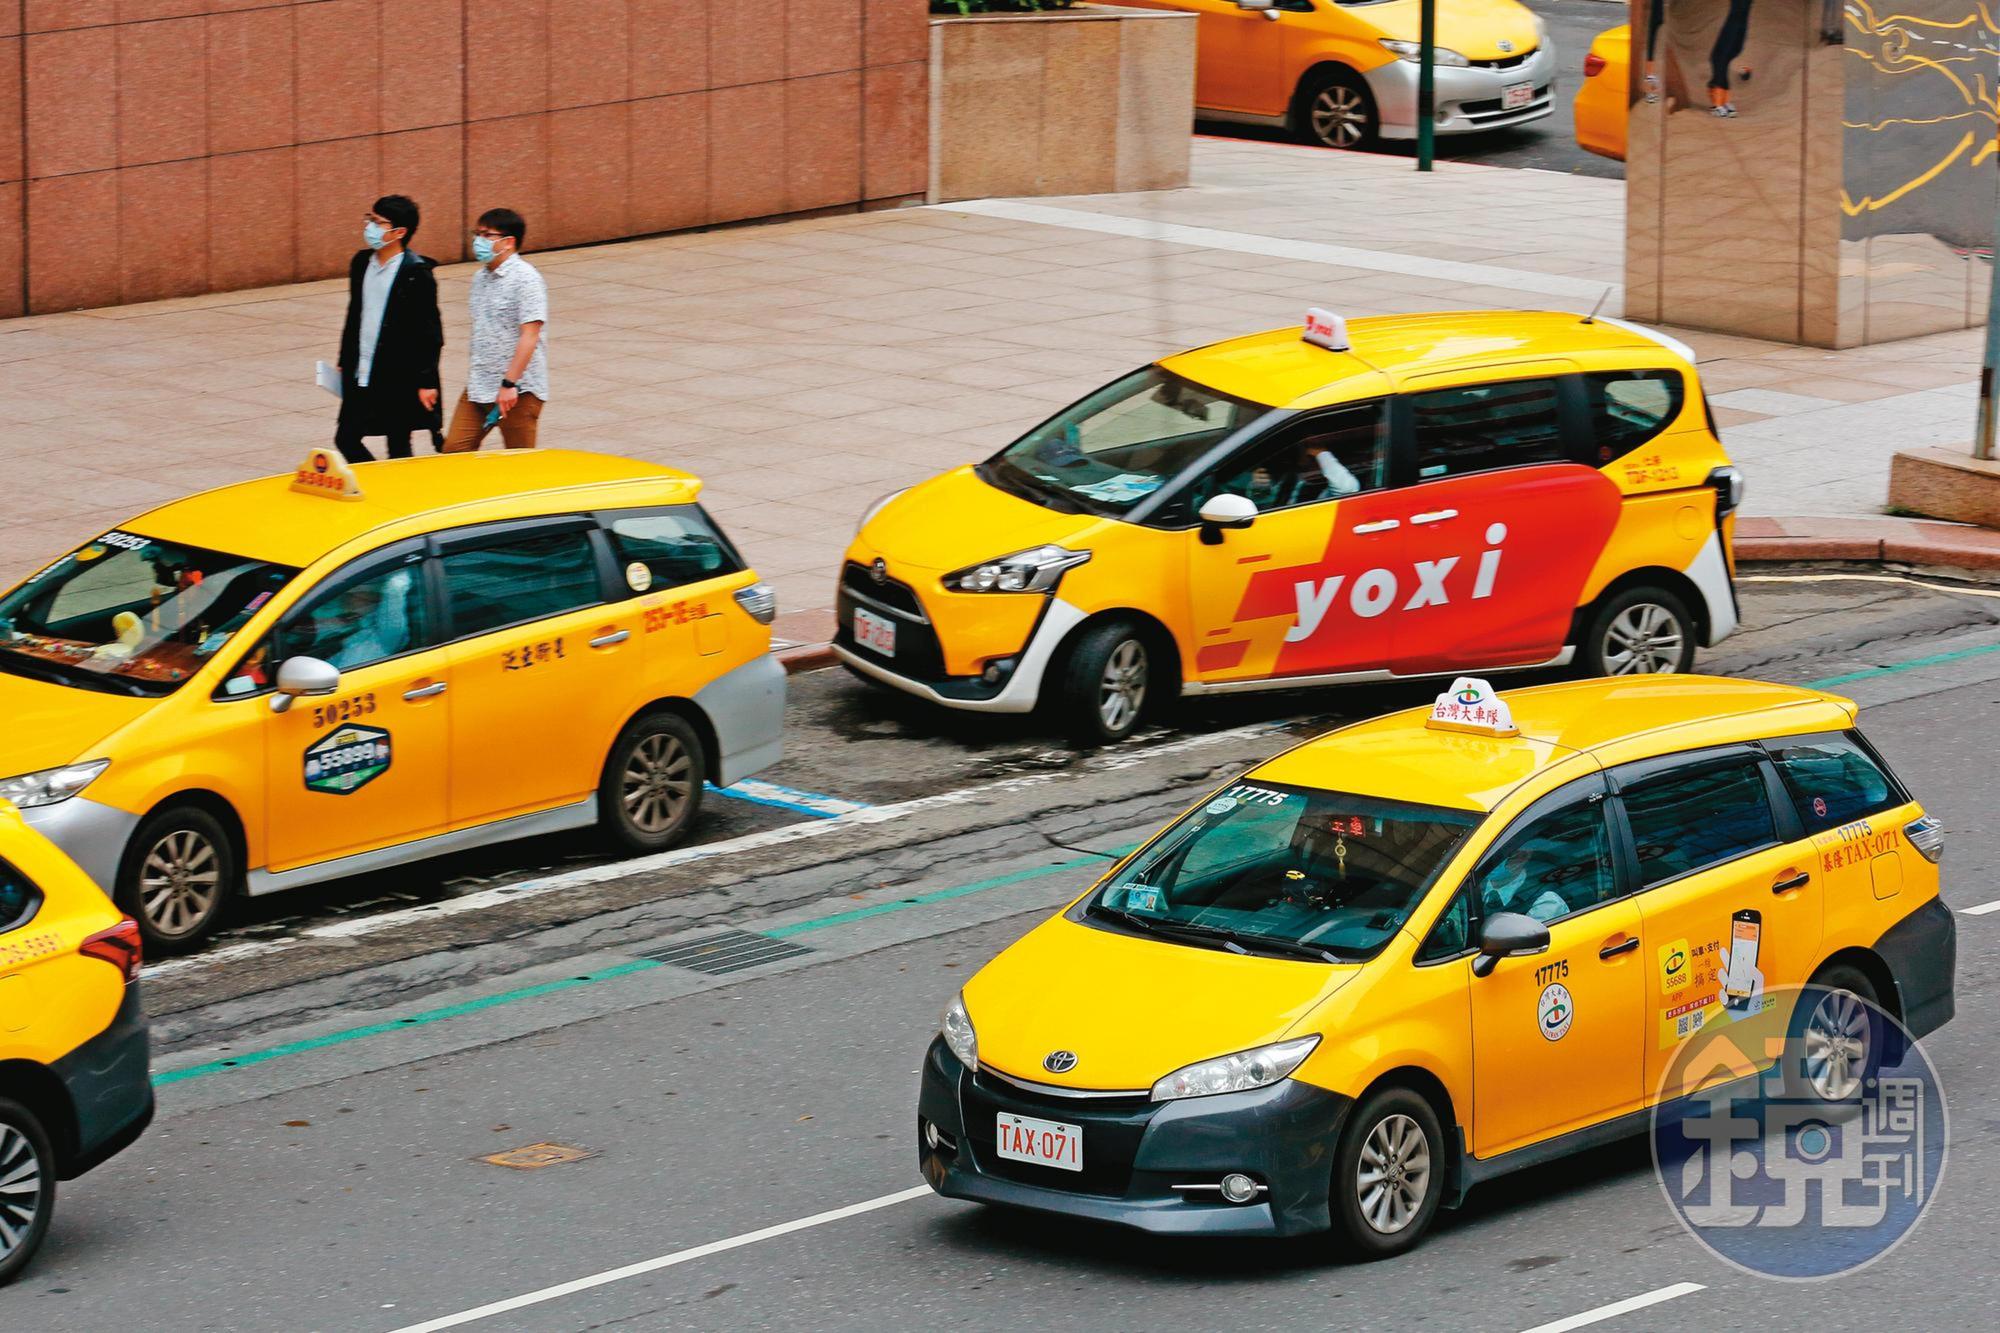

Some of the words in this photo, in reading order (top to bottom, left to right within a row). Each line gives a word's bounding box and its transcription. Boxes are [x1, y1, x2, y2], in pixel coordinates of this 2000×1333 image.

[97, 532, 151, 551] 50253
[1284, 523, 1507, 642] yoxi
[313, 693, 376, 728] 50253
[1436, 703, 1499, 725] 台灣大車隊
[320, 742, 375, 770] 55899
[1228, 785, 1290, 806] 17775
[1837, 820, 1872, 842] 17775
[1535, 959, 1569, 987] 17775
[1666, 973, 1687, 989] 55688
